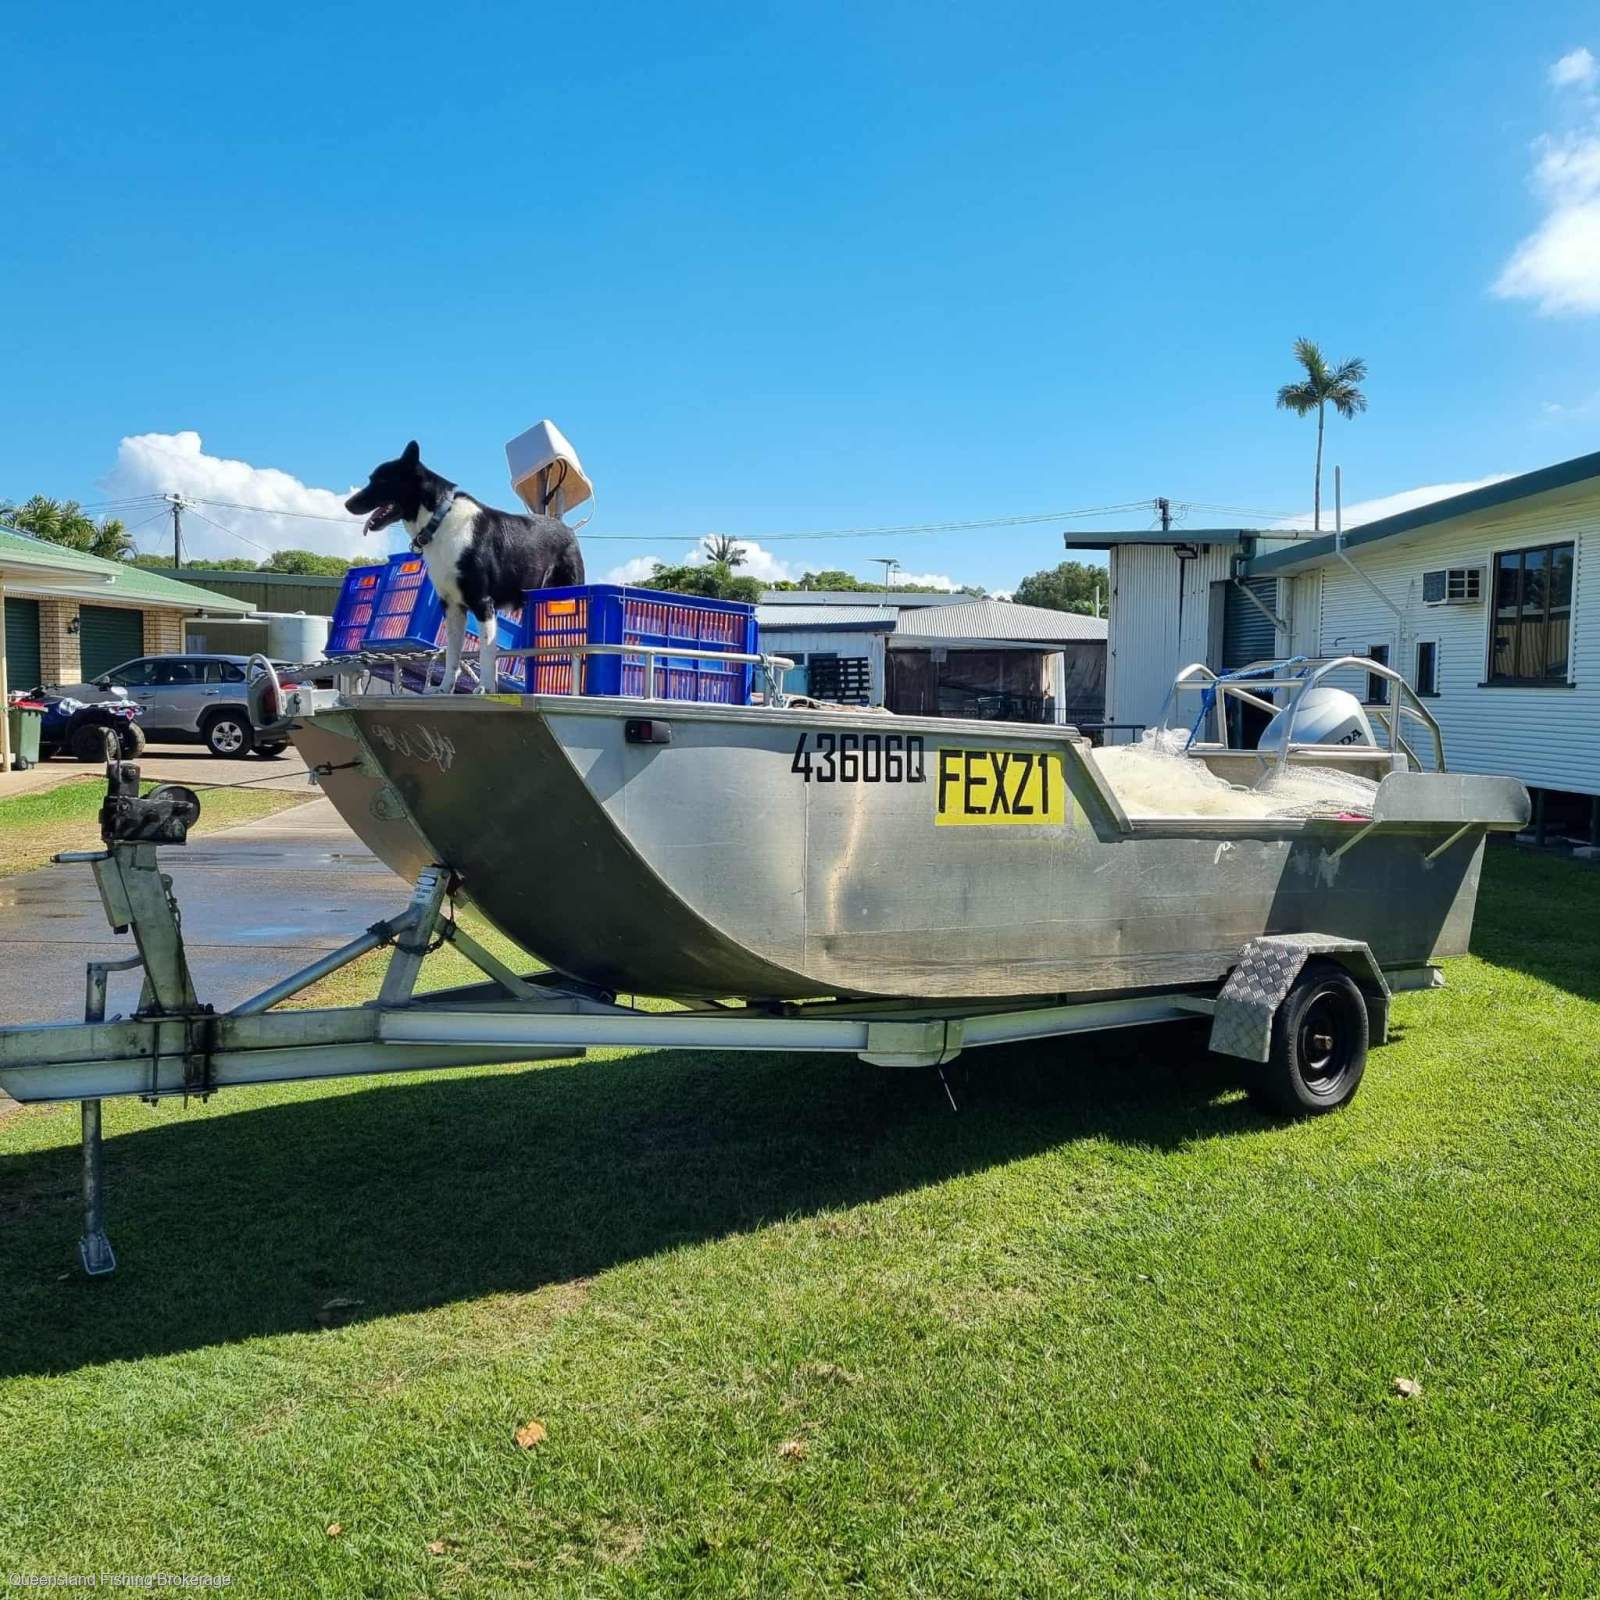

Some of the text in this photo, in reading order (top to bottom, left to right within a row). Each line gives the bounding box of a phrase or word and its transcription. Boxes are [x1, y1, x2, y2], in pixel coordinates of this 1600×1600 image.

[791, 733, 926, 783] 43606Q
[1336, 728, 1362, 745] DA
[938, 749, 1049, 814] FEXZ1
